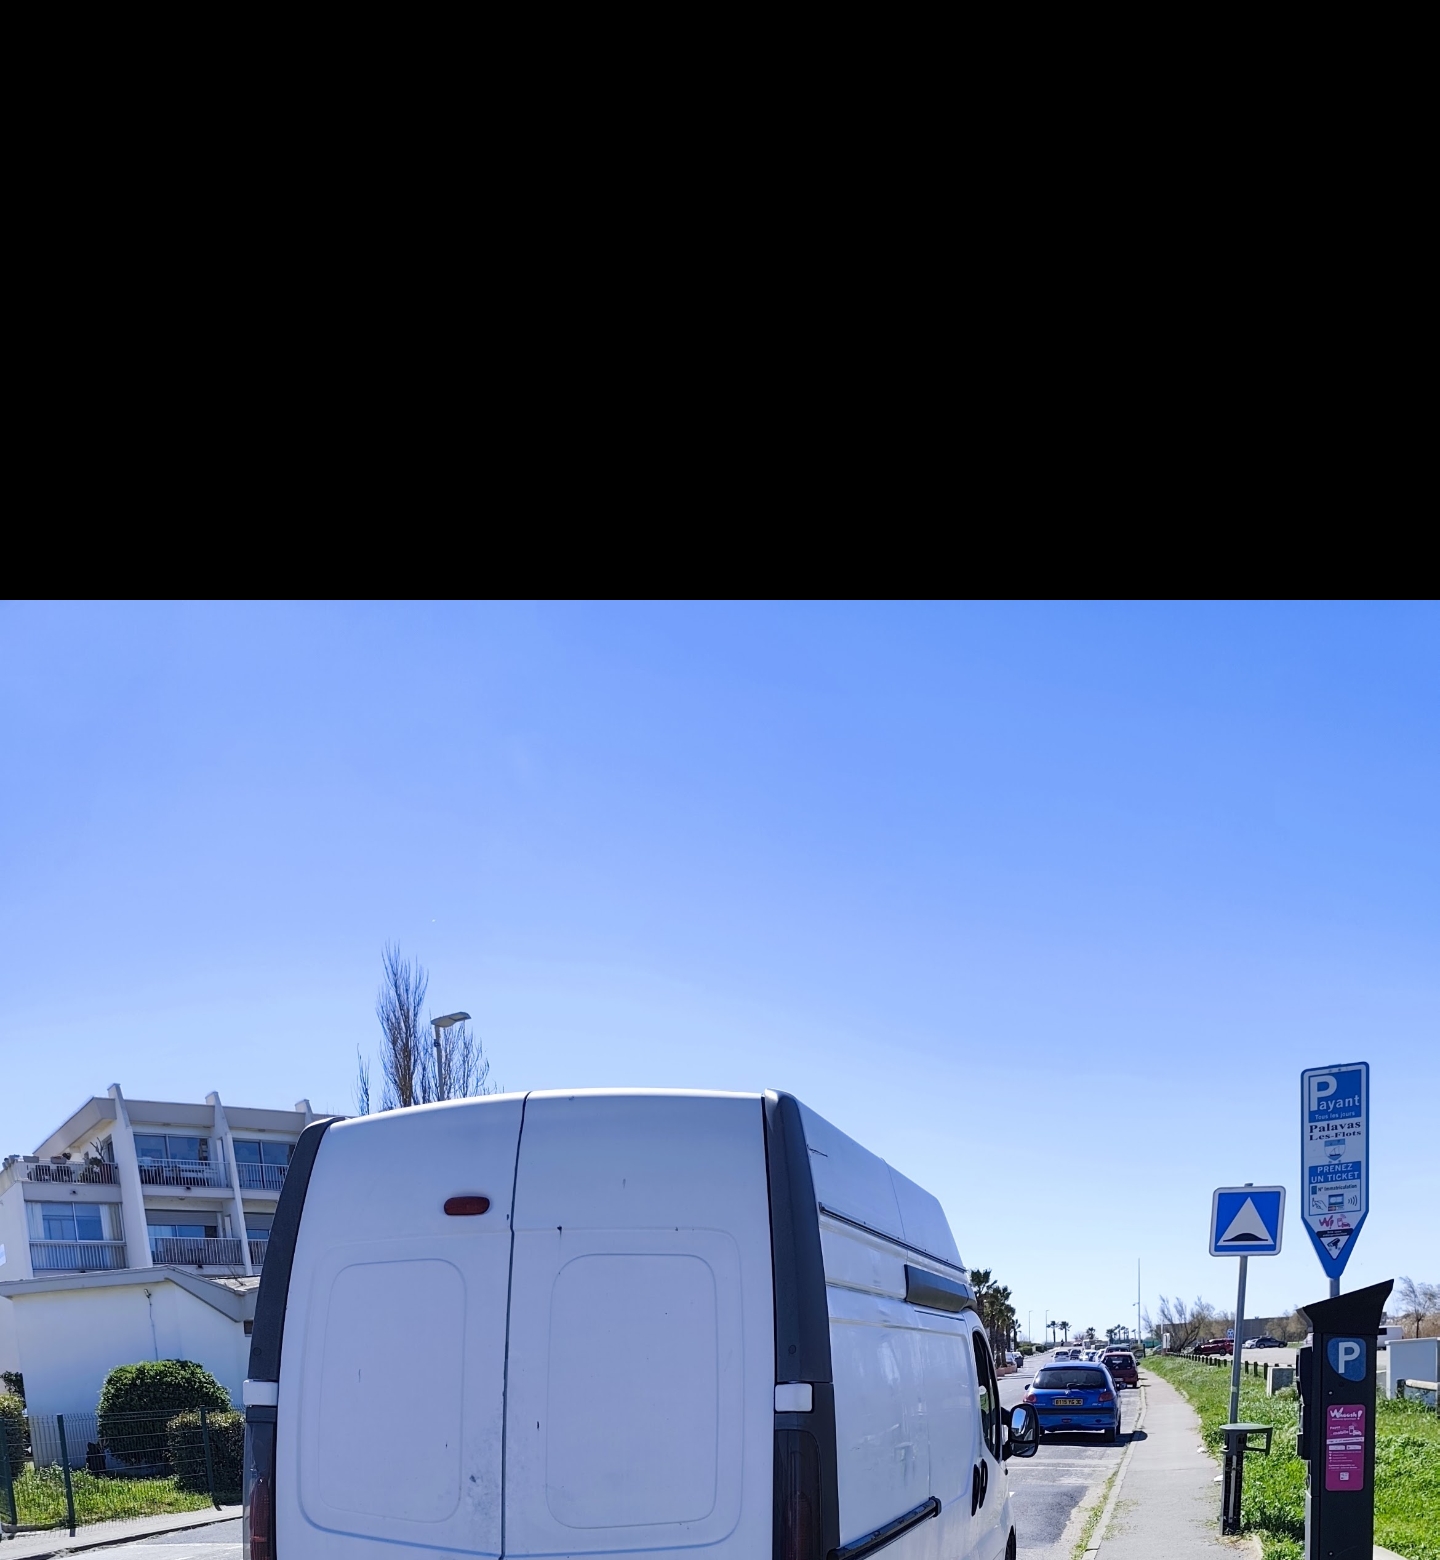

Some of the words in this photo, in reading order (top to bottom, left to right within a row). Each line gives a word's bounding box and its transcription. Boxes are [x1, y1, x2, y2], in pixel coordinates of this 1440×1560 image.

[1309, 1074, 1360, 1112] Payant
[1309, 1121, 1362, 1134] Palavas
[1309, 1130, 1362, 1141] Les-Flots
[1317, 1163, 1353, 1174] PRENEZ
[1311, 1175, 1324, 1183] UN
[1327, 1171, 1359, 1182] TICKET
[1338, 1341, 1361, 1374] P
